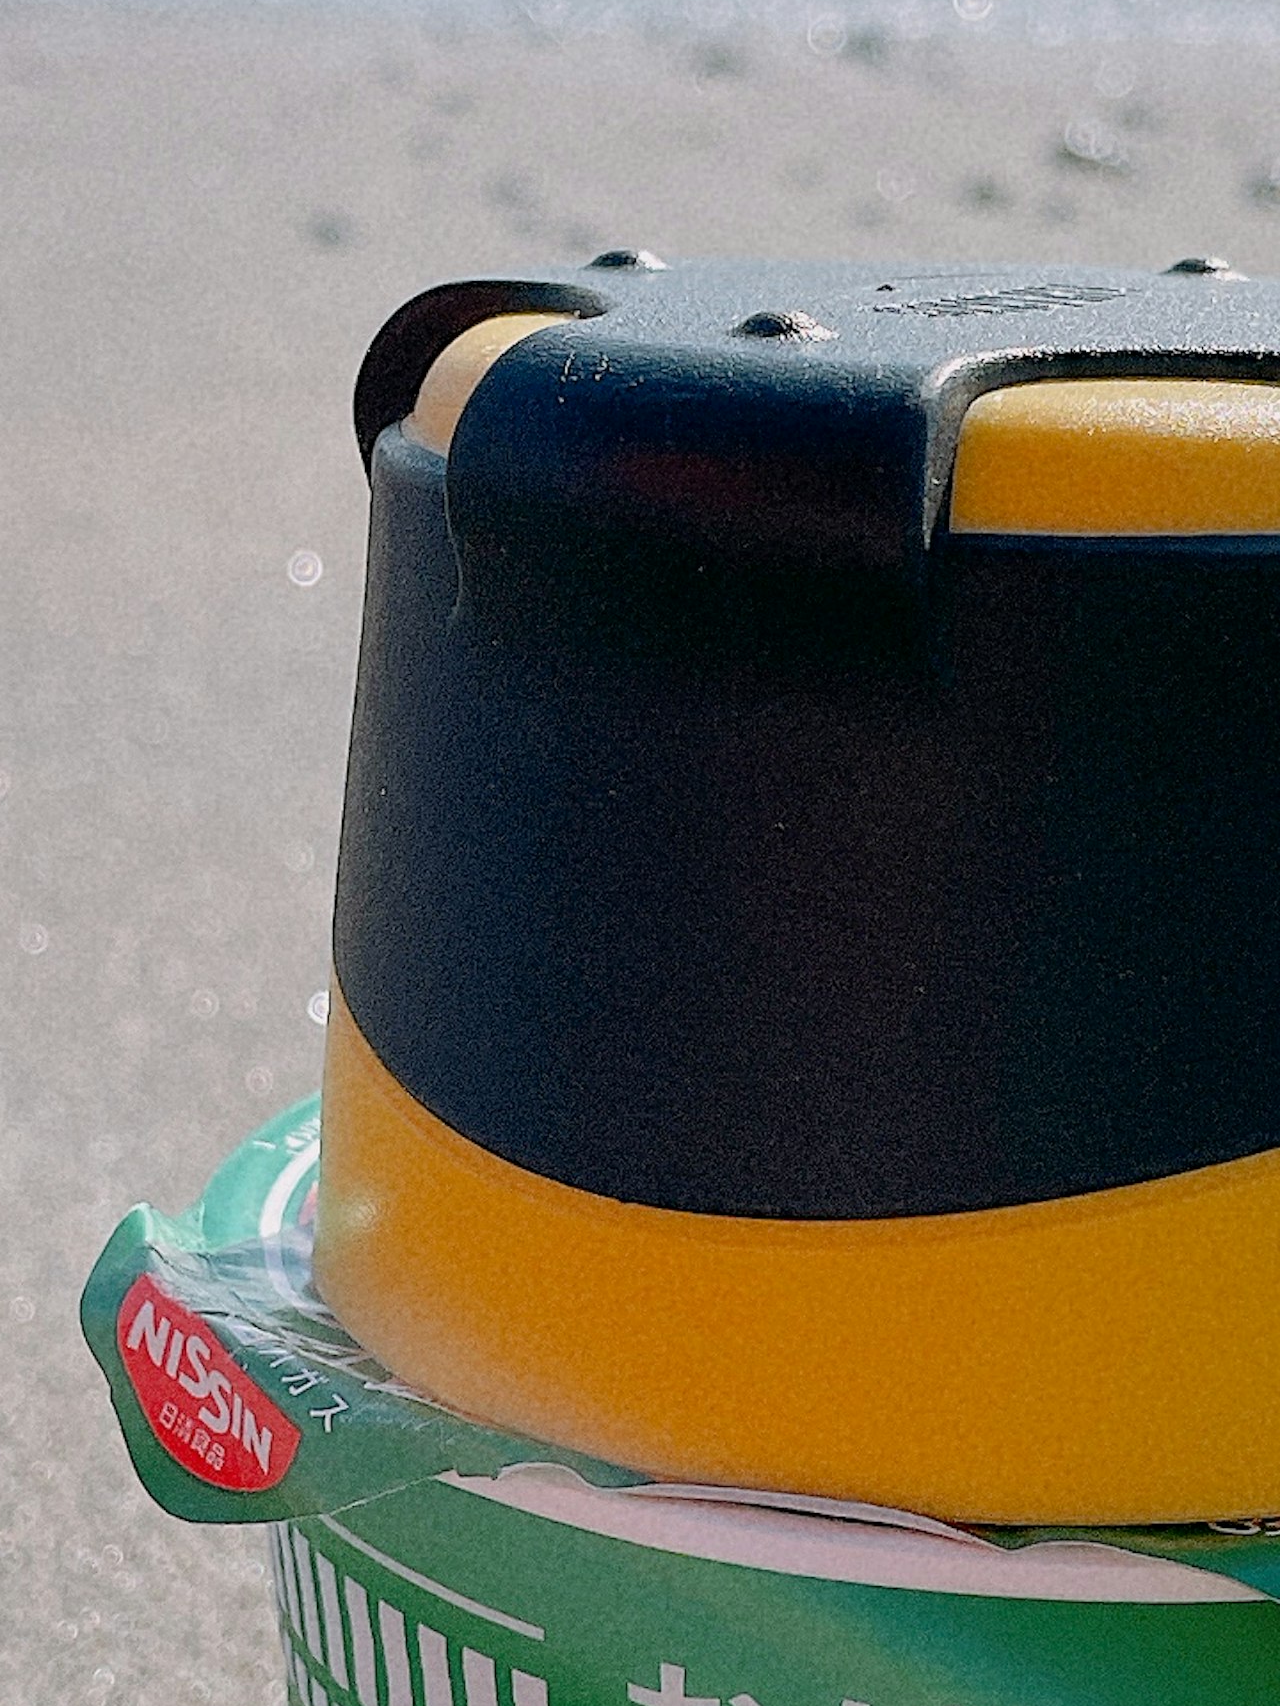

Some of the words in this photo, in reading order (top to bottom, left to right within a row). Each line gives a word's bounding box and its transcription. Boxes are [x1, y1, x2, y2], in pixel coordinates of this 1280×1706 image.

[126, 1300, 273, 1476] NISSIN
[159, 1400, 226, 1471] 日清食品
